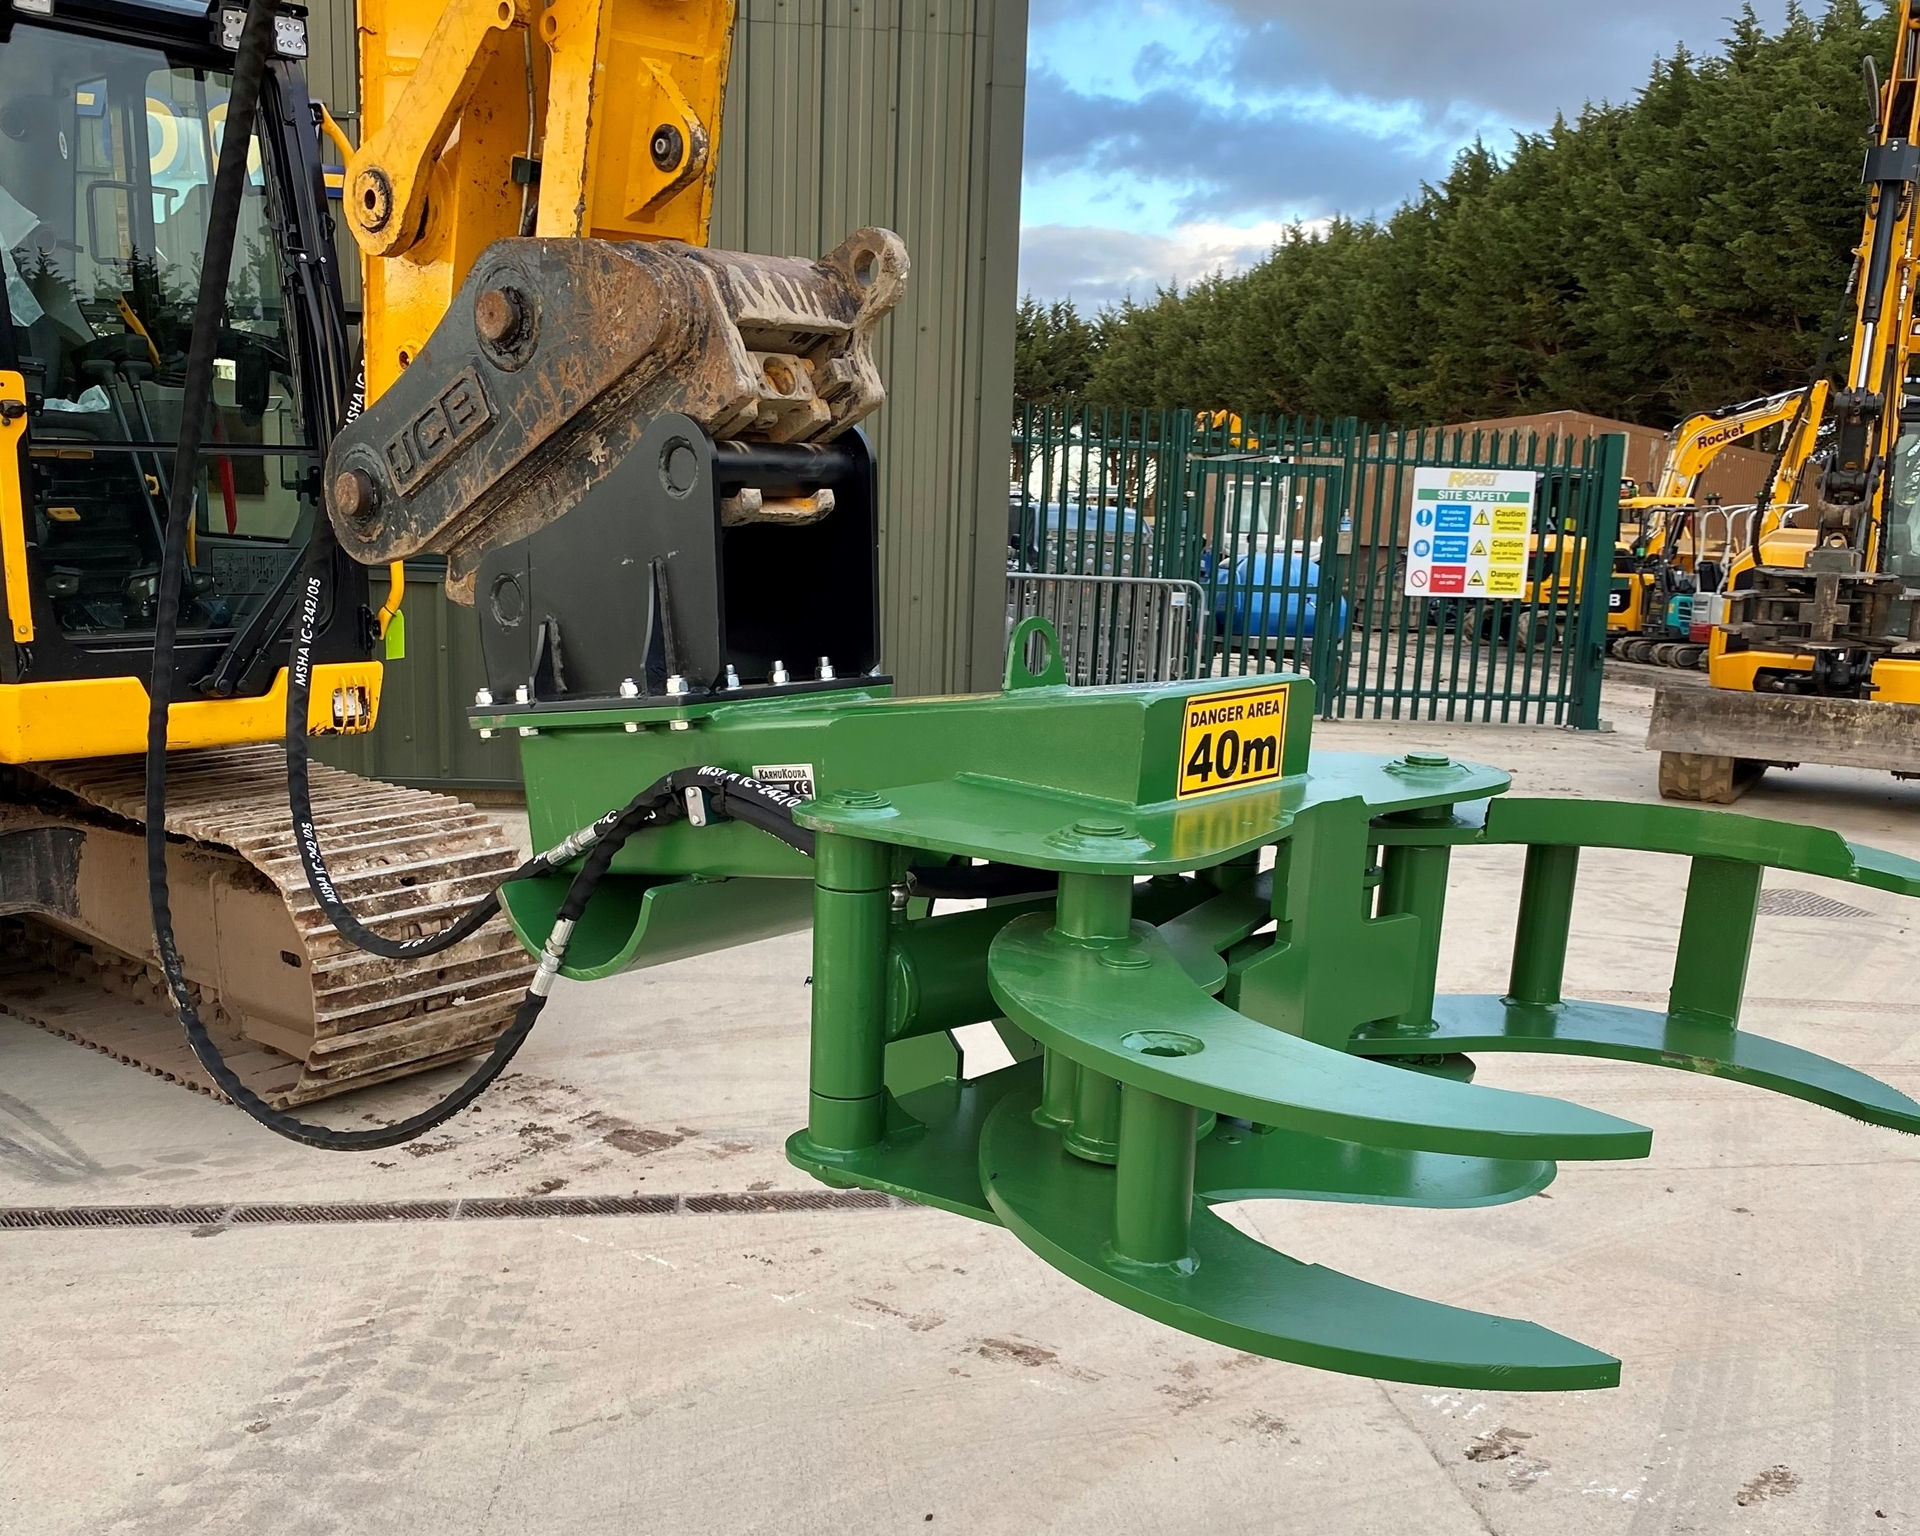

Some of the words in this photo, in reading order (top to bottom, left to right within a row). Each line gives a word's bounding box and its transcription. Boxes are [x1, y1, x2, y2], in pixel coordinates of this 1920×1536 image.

[385, 378, 477, 482] JCB
[1697, 422, 1745, 450] Rocket
[1437, 490, 1463, 500] SITE
[1466, 491, 1510, 501] SAFETY
[1495, 509, 1526, 518] Caution
[1492, 540, 1524, 548] Caution
[1490, 570, 1520, 579] Danger
[299, 577, 321, 645] IC-242/05
[294, 647, 310, 687] MSHA
[1190, 705, 1243, 728] DANGER
[1246, 699, 1280, 719] AREA
[1186, 729, 1277, 783] 40m
